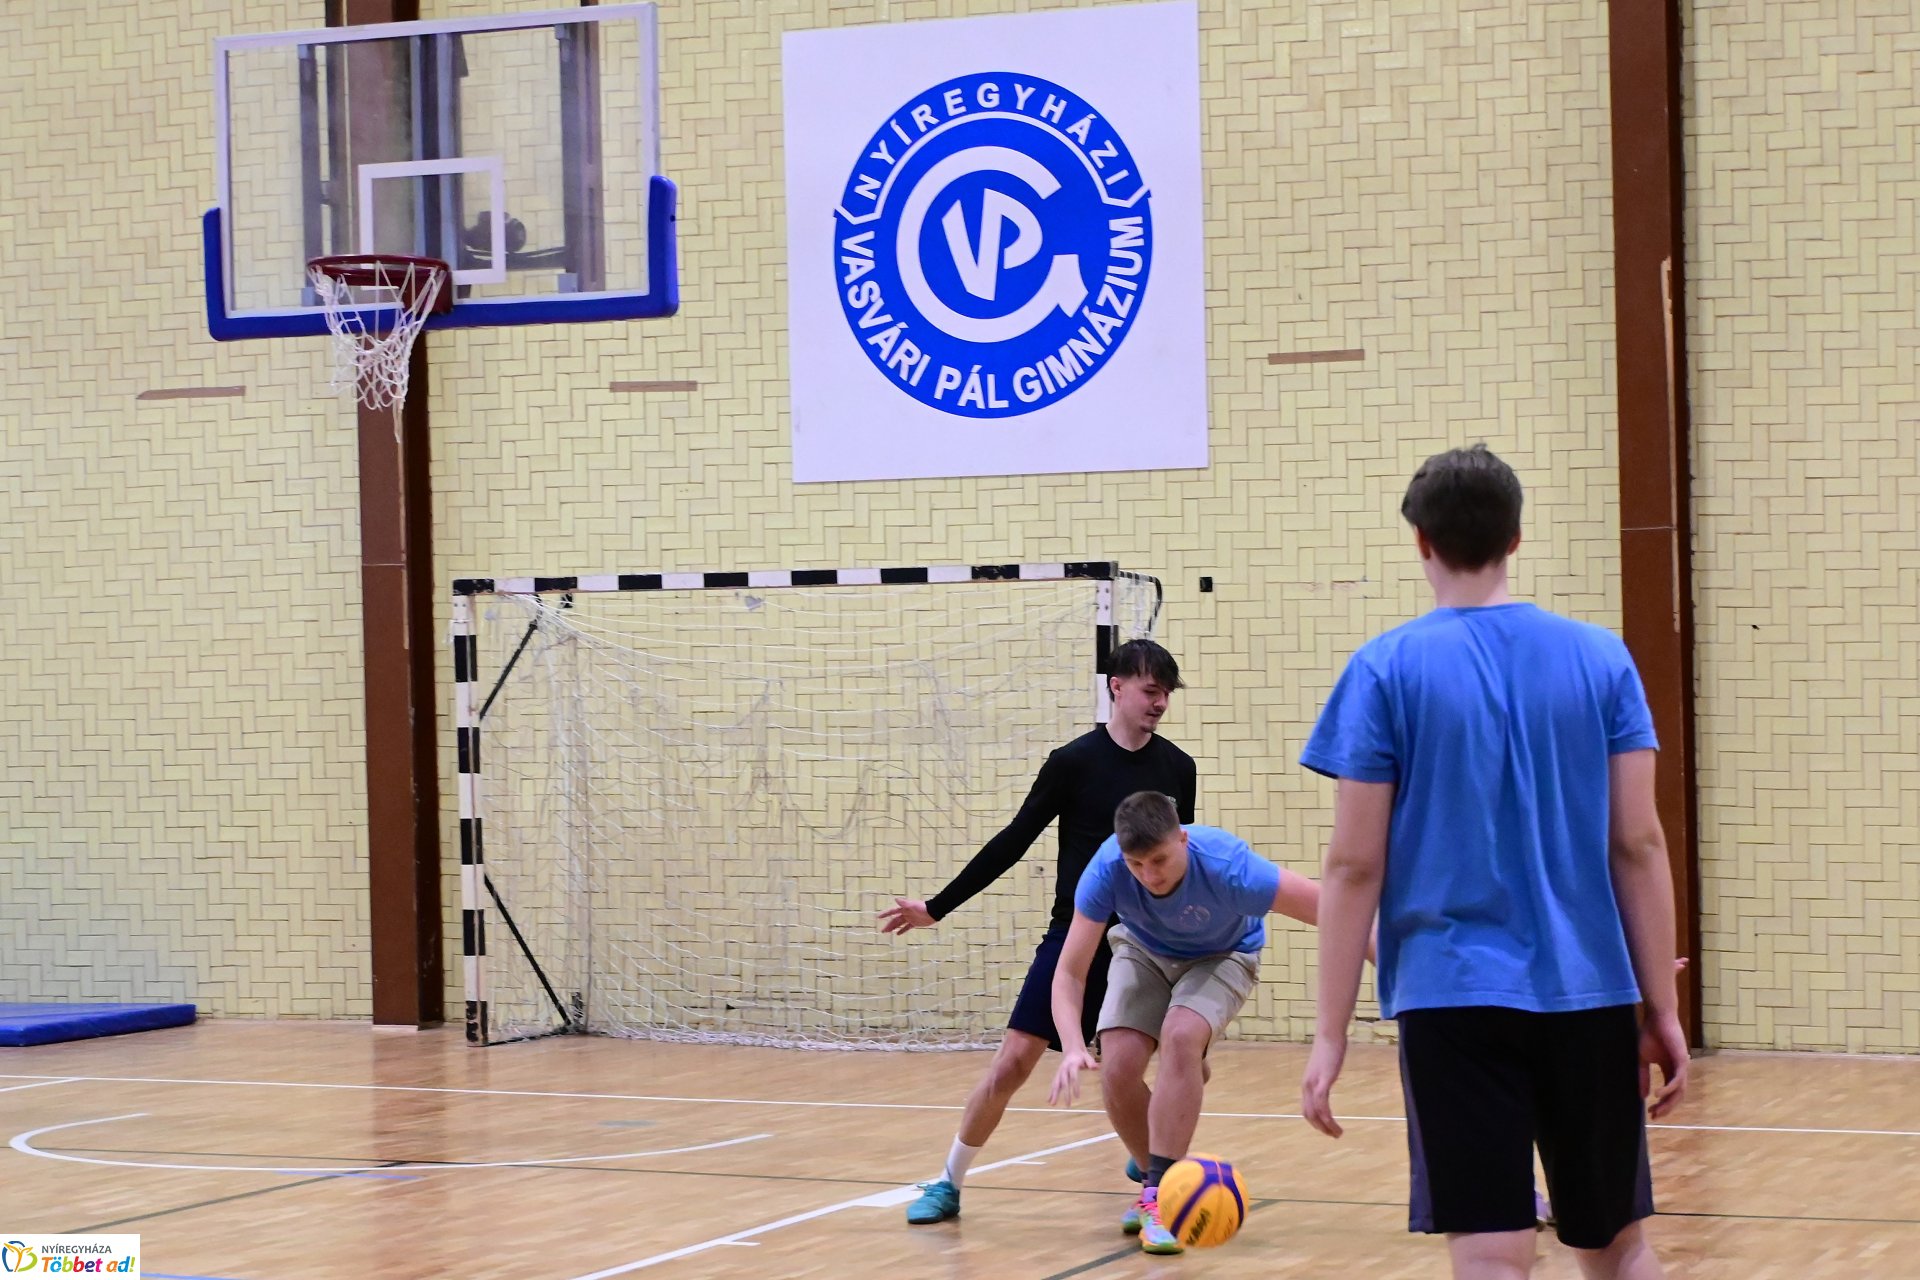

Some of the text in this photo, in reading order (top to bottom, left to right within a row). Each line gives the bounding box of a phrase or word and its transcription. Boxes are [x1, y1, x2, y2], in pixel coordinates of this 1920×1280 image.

[854, 82, 1129, 200] NYÍREGYHÁZI
[841, 215, 1145, 409] VASVÁRI PÁL GIMNÁZIUM
